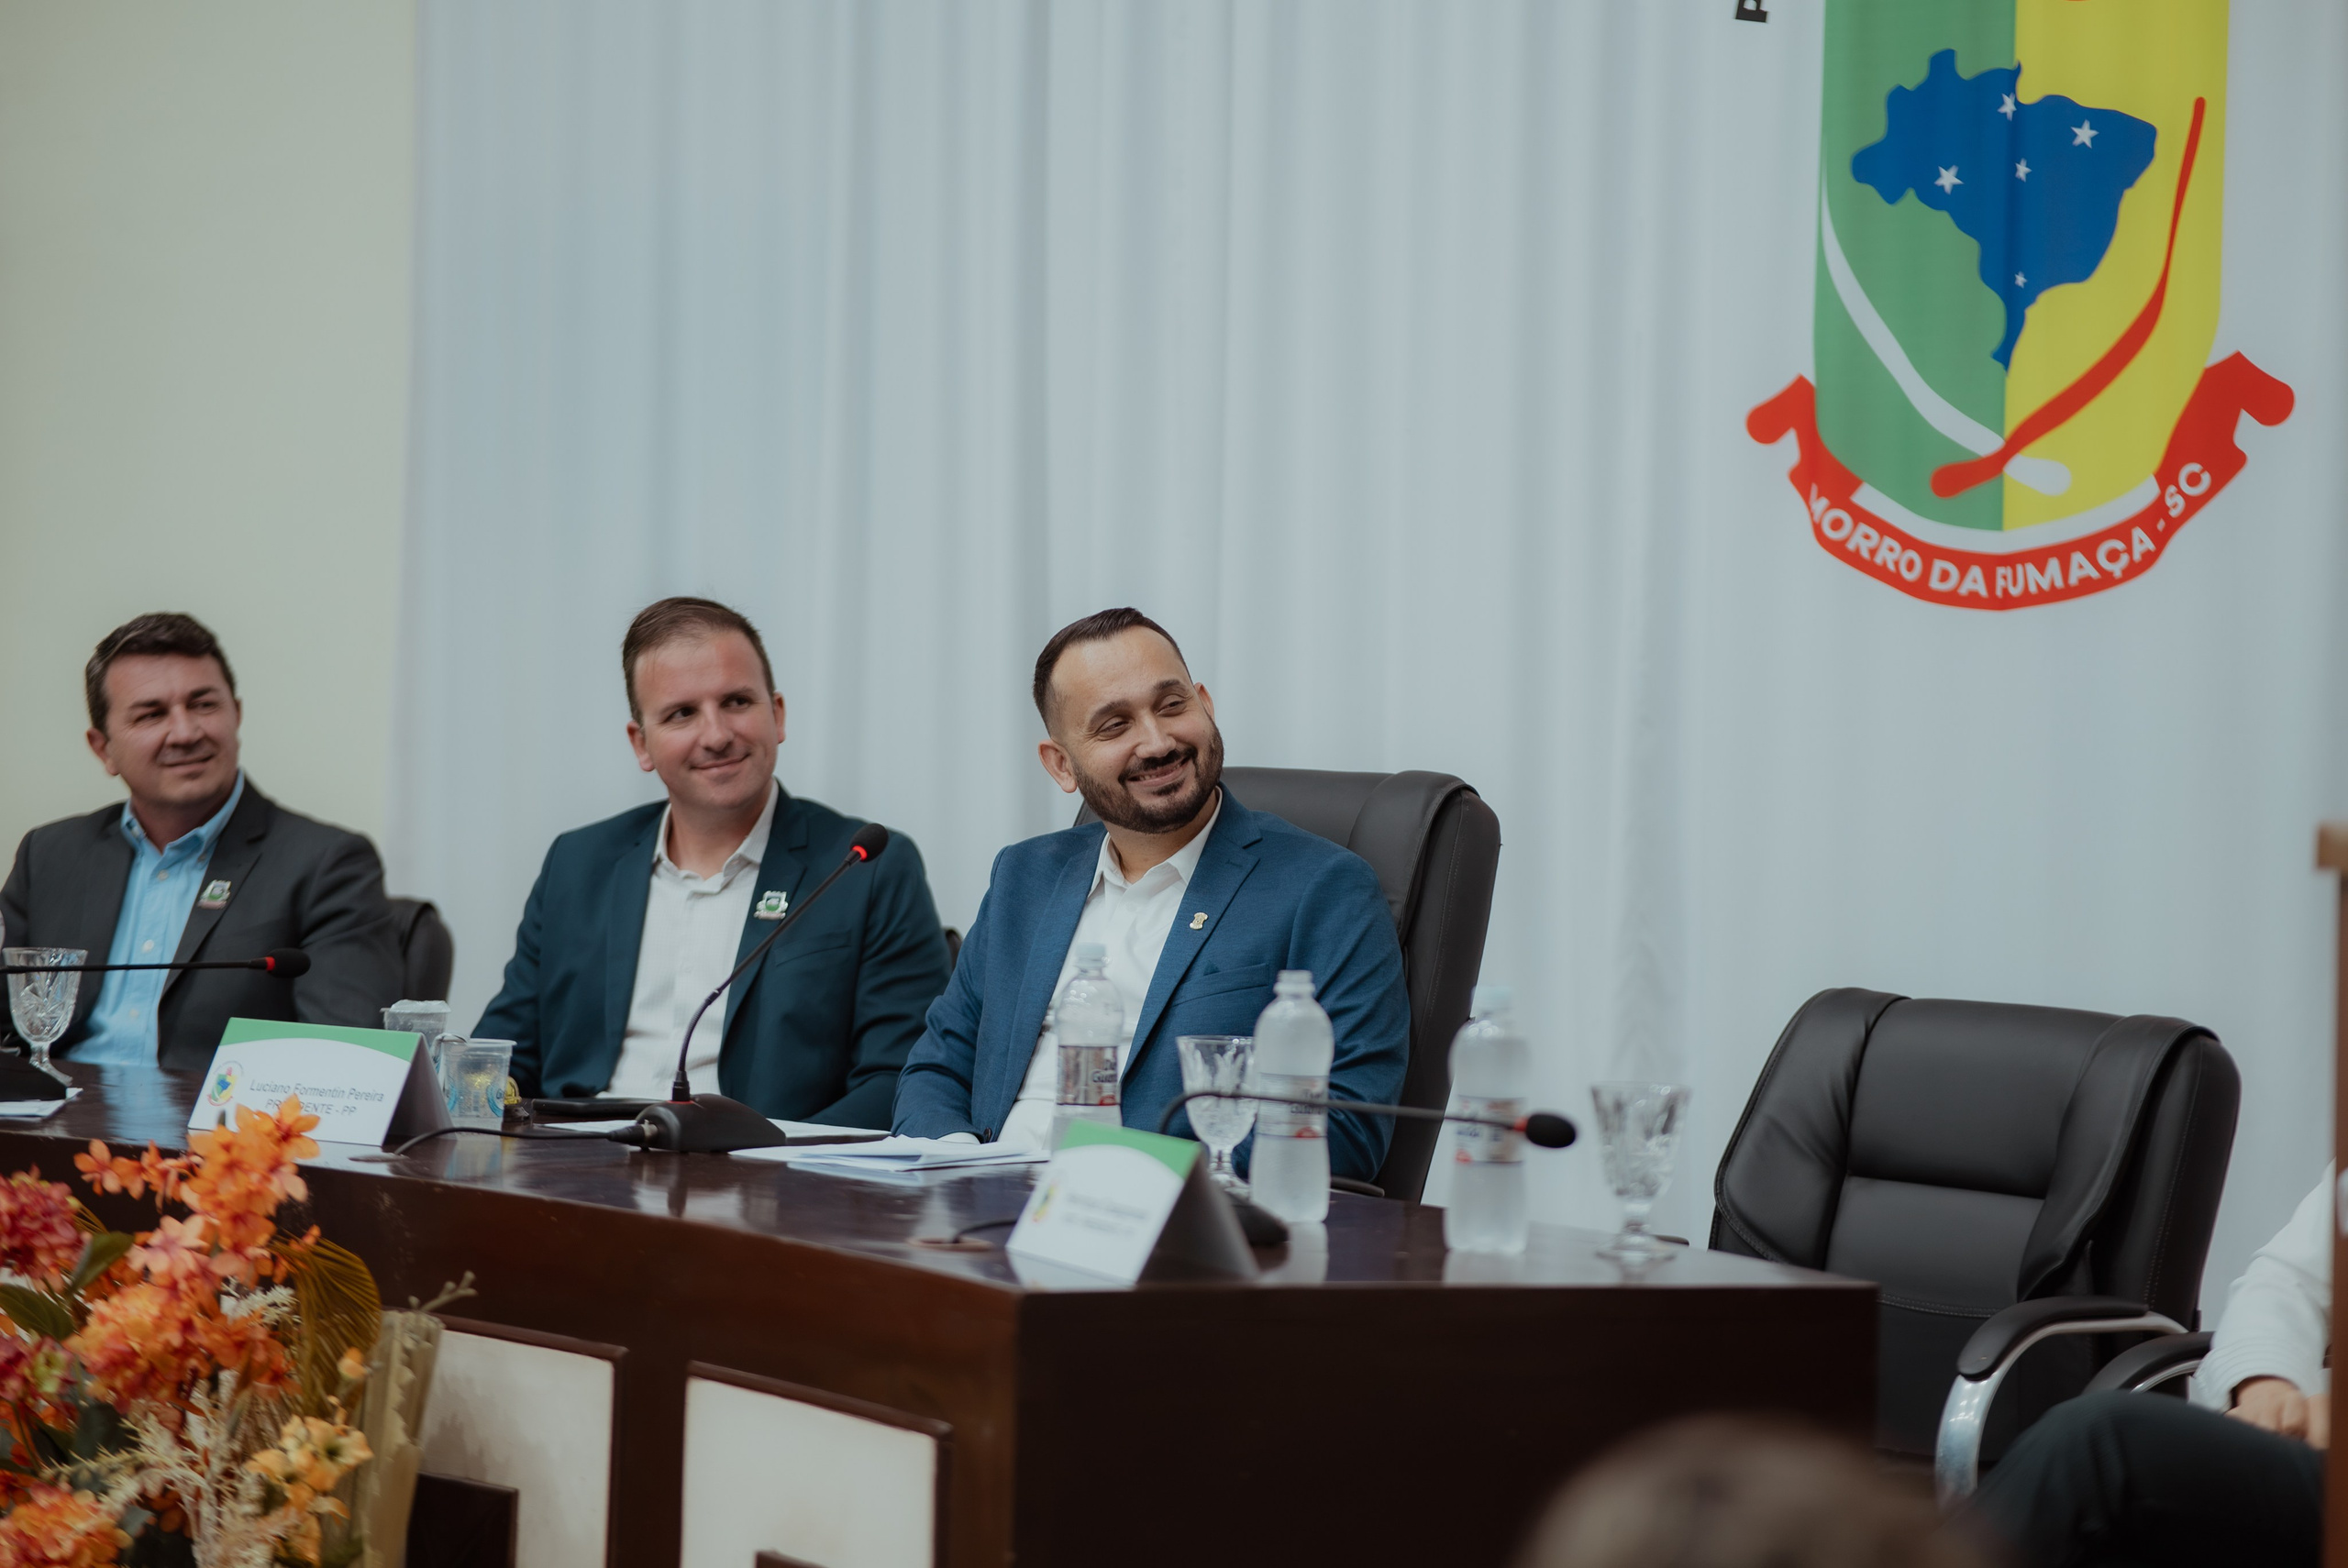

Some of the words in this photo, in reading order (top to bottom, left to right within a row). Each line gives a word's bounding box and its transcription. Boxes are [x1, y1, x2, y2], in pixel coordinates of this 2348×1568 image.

[1928, 558, 1988, 598] DA
[1995, 526, 2156, 598] FUMAÇA
[2165, 462, 2211, 518] SC
[249, 1079, 291, 1094] Luciano
[294, 1082, 345, 1099] Formentin
[348, 1088, 384, 1102] Pereira
[265, 1099, 334, 1115] PRDENTE
